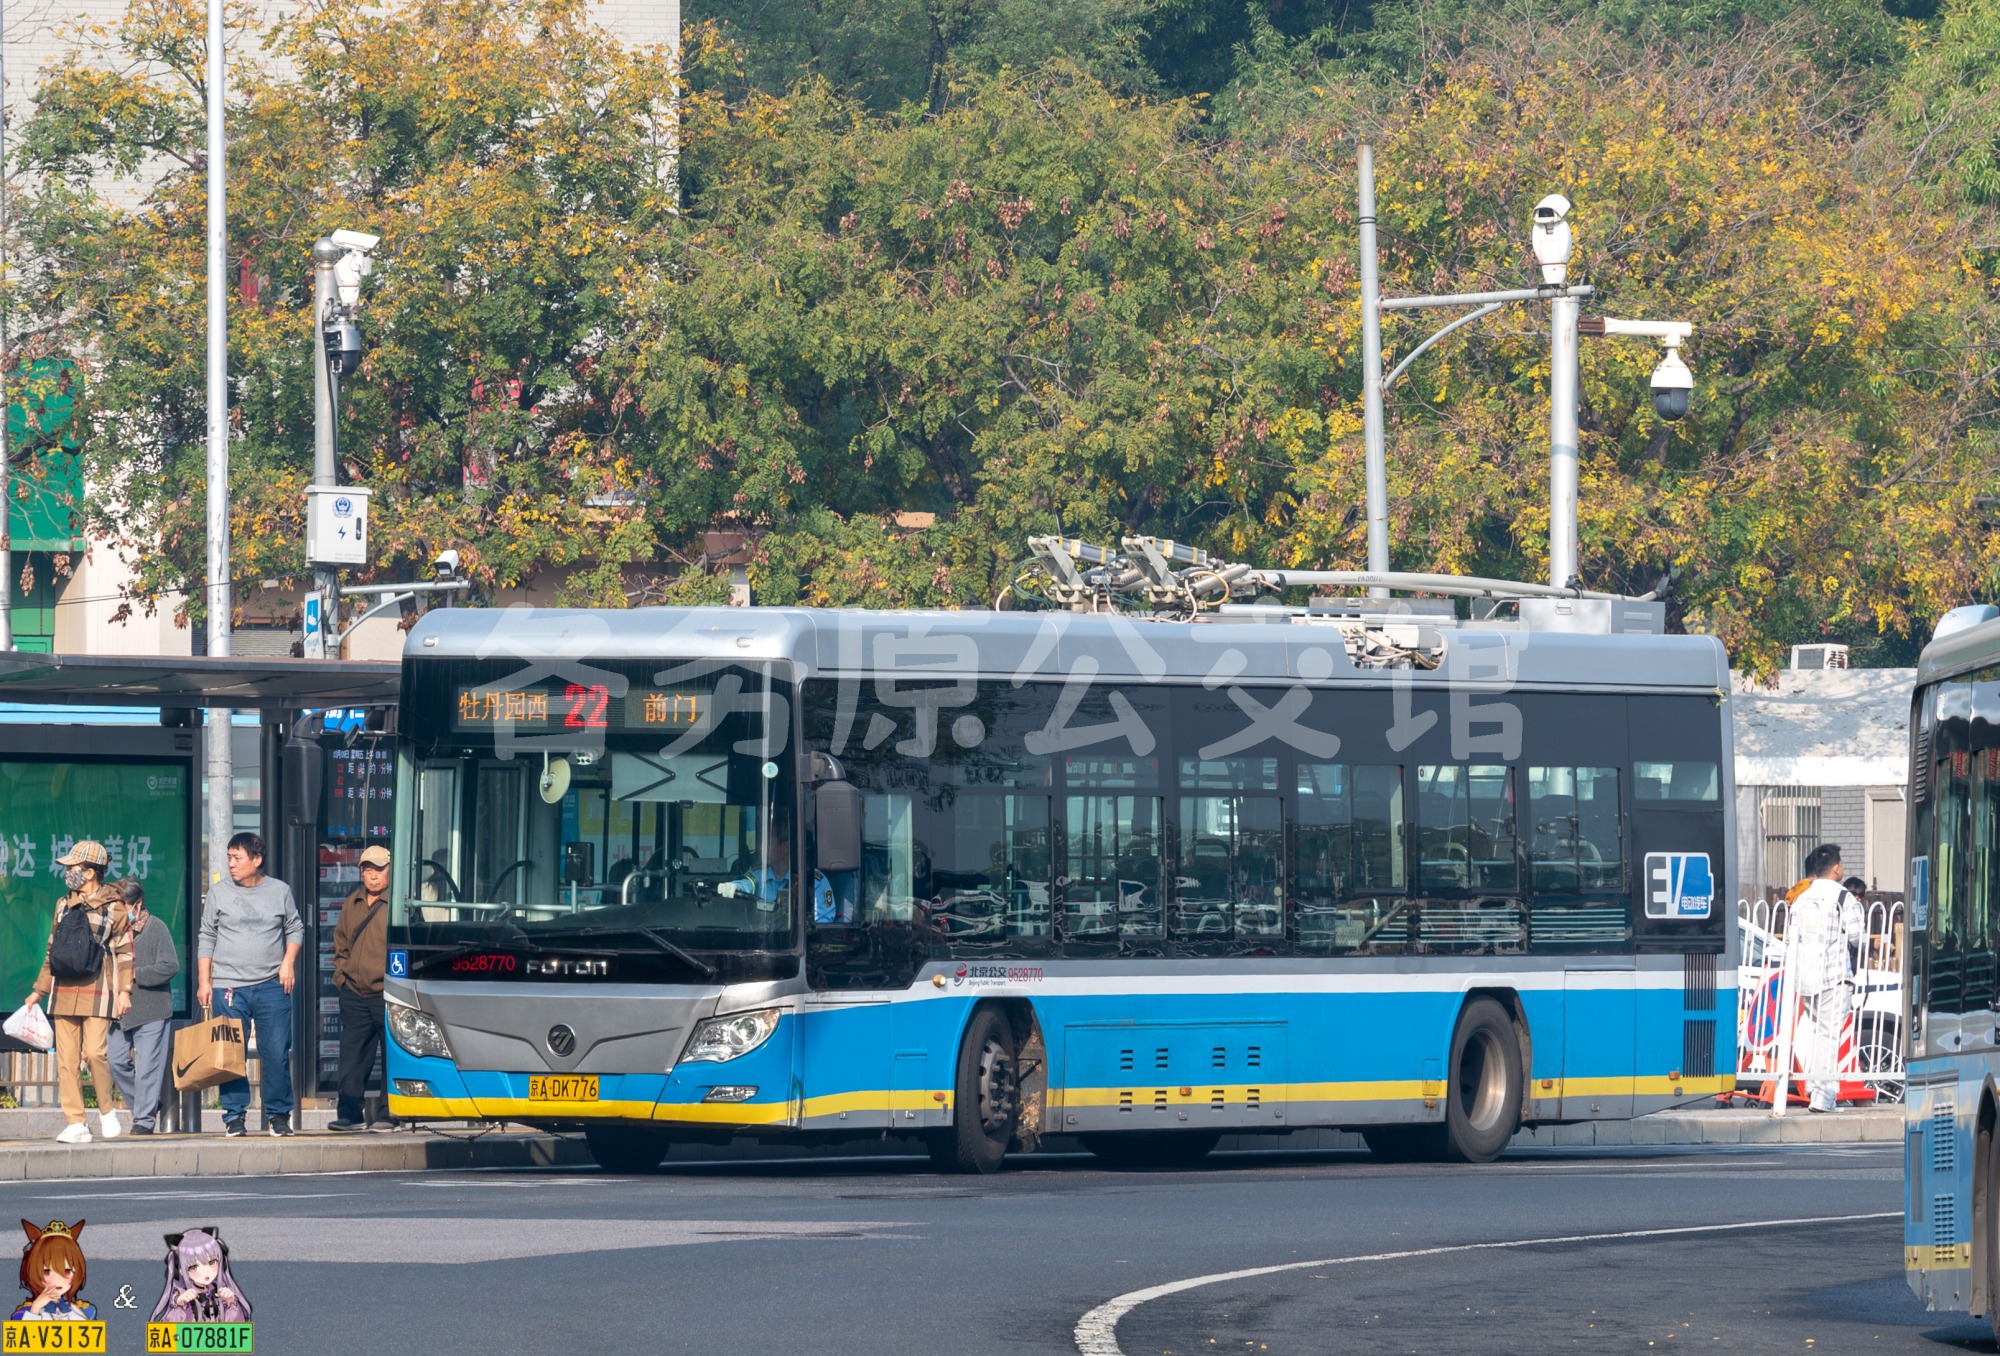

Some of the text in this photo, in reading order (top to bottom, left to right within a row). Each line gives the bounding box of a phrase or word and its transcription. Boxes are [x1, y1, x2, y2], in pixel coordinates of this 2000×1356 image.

[458, 685, 697, 728] 牡丹园西 22 前门
[49, 834, 152, 880] 城美好
[1645, 854, 1687, 916] EV
[452, 955, 516, 971] 9528770
[526, 960, 607, 975] FOTON
[969, 966, 1043, 982] 北京公交 9528770
[211, 1024, 242, 1043] NIKE
[531, 1079, 597, 1098] 京A·DK776
